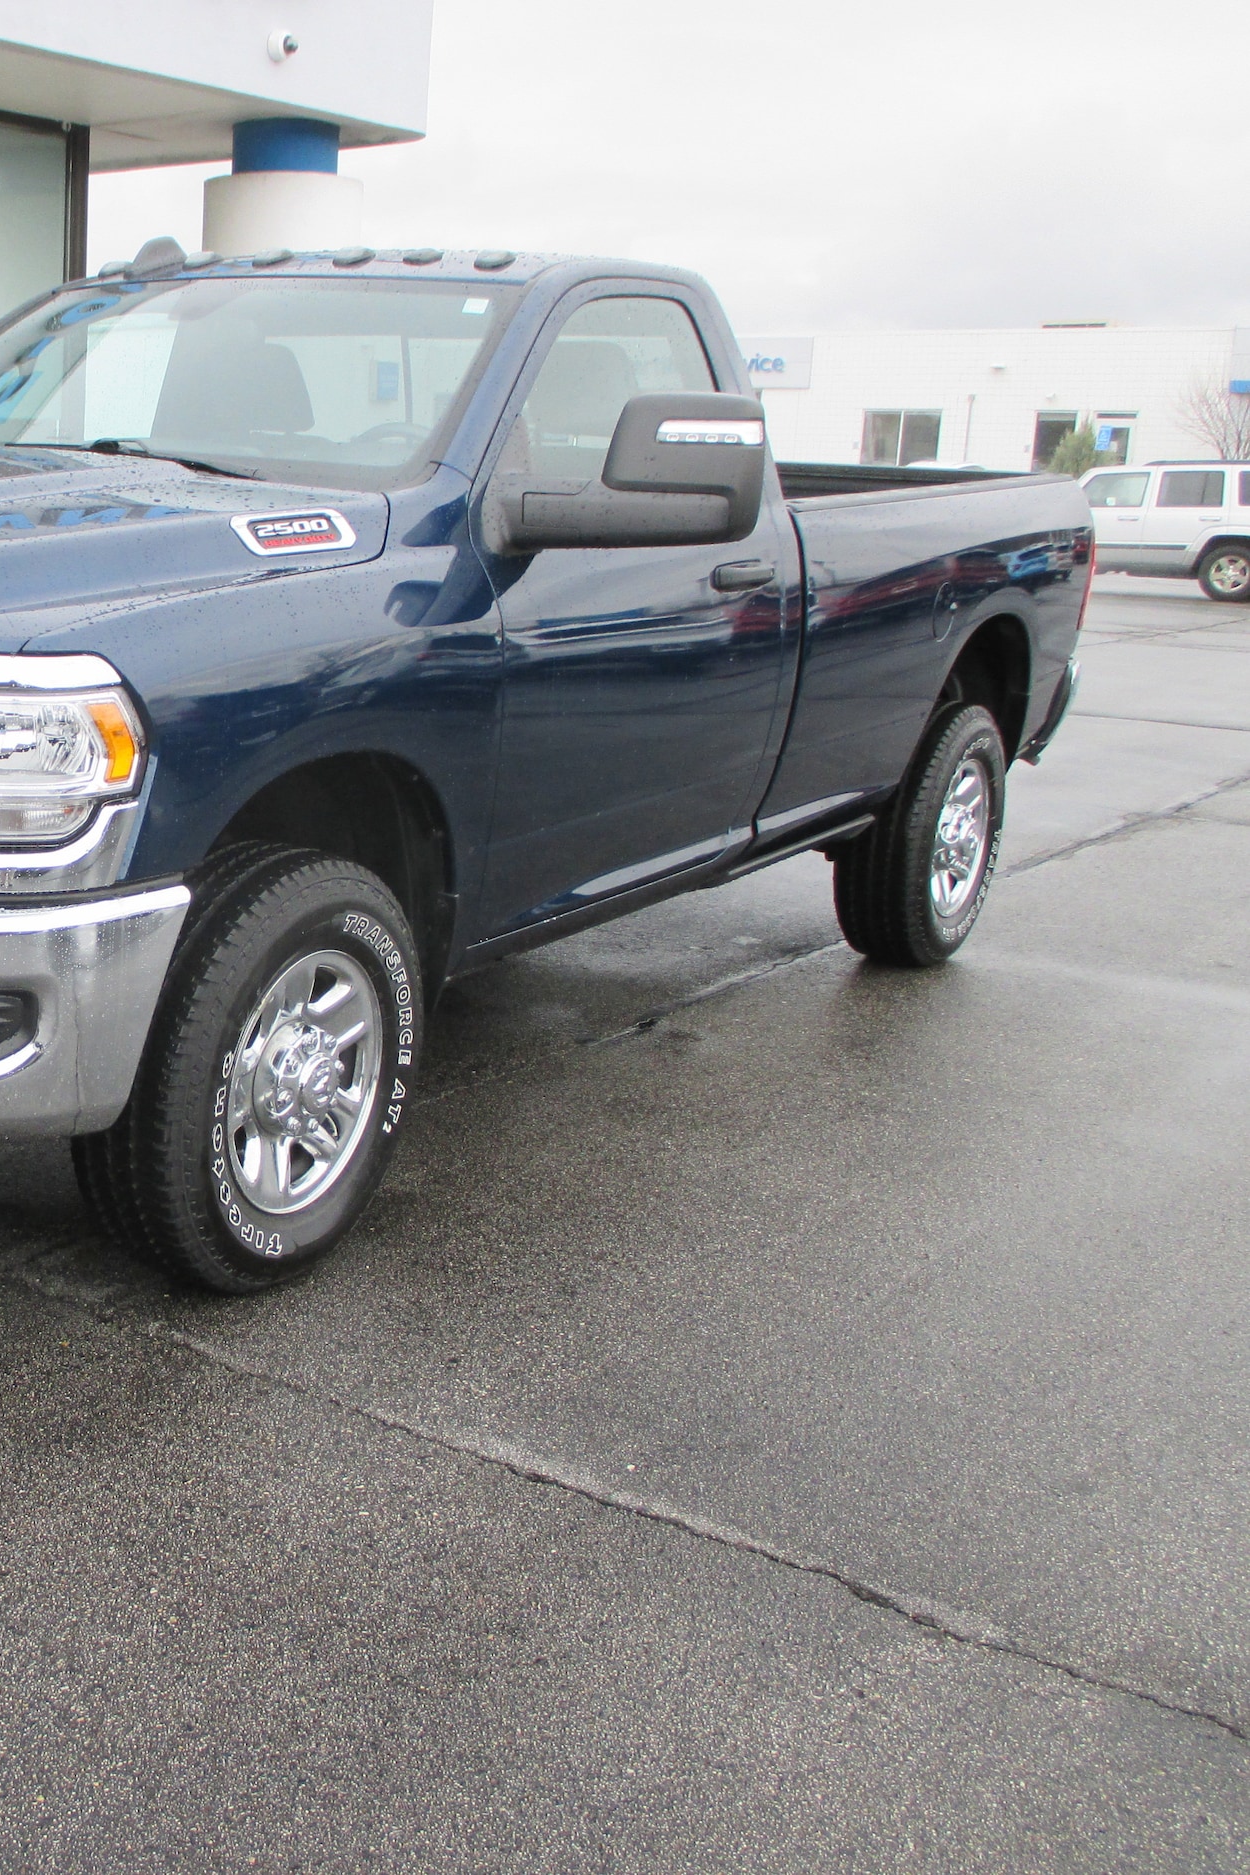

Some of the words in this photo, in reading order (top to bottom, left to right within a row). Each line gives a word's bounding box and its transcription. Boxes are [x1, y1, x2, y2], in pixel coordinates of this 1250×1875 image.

[747, 352, 786, 373] vice
[255, 518, 330, 538] 2500
[264, 536, 303, 547] HEAVY
[303, 534, 336, 544] DUTY
[342, 913, 414, 1067] TRANSFORCE
